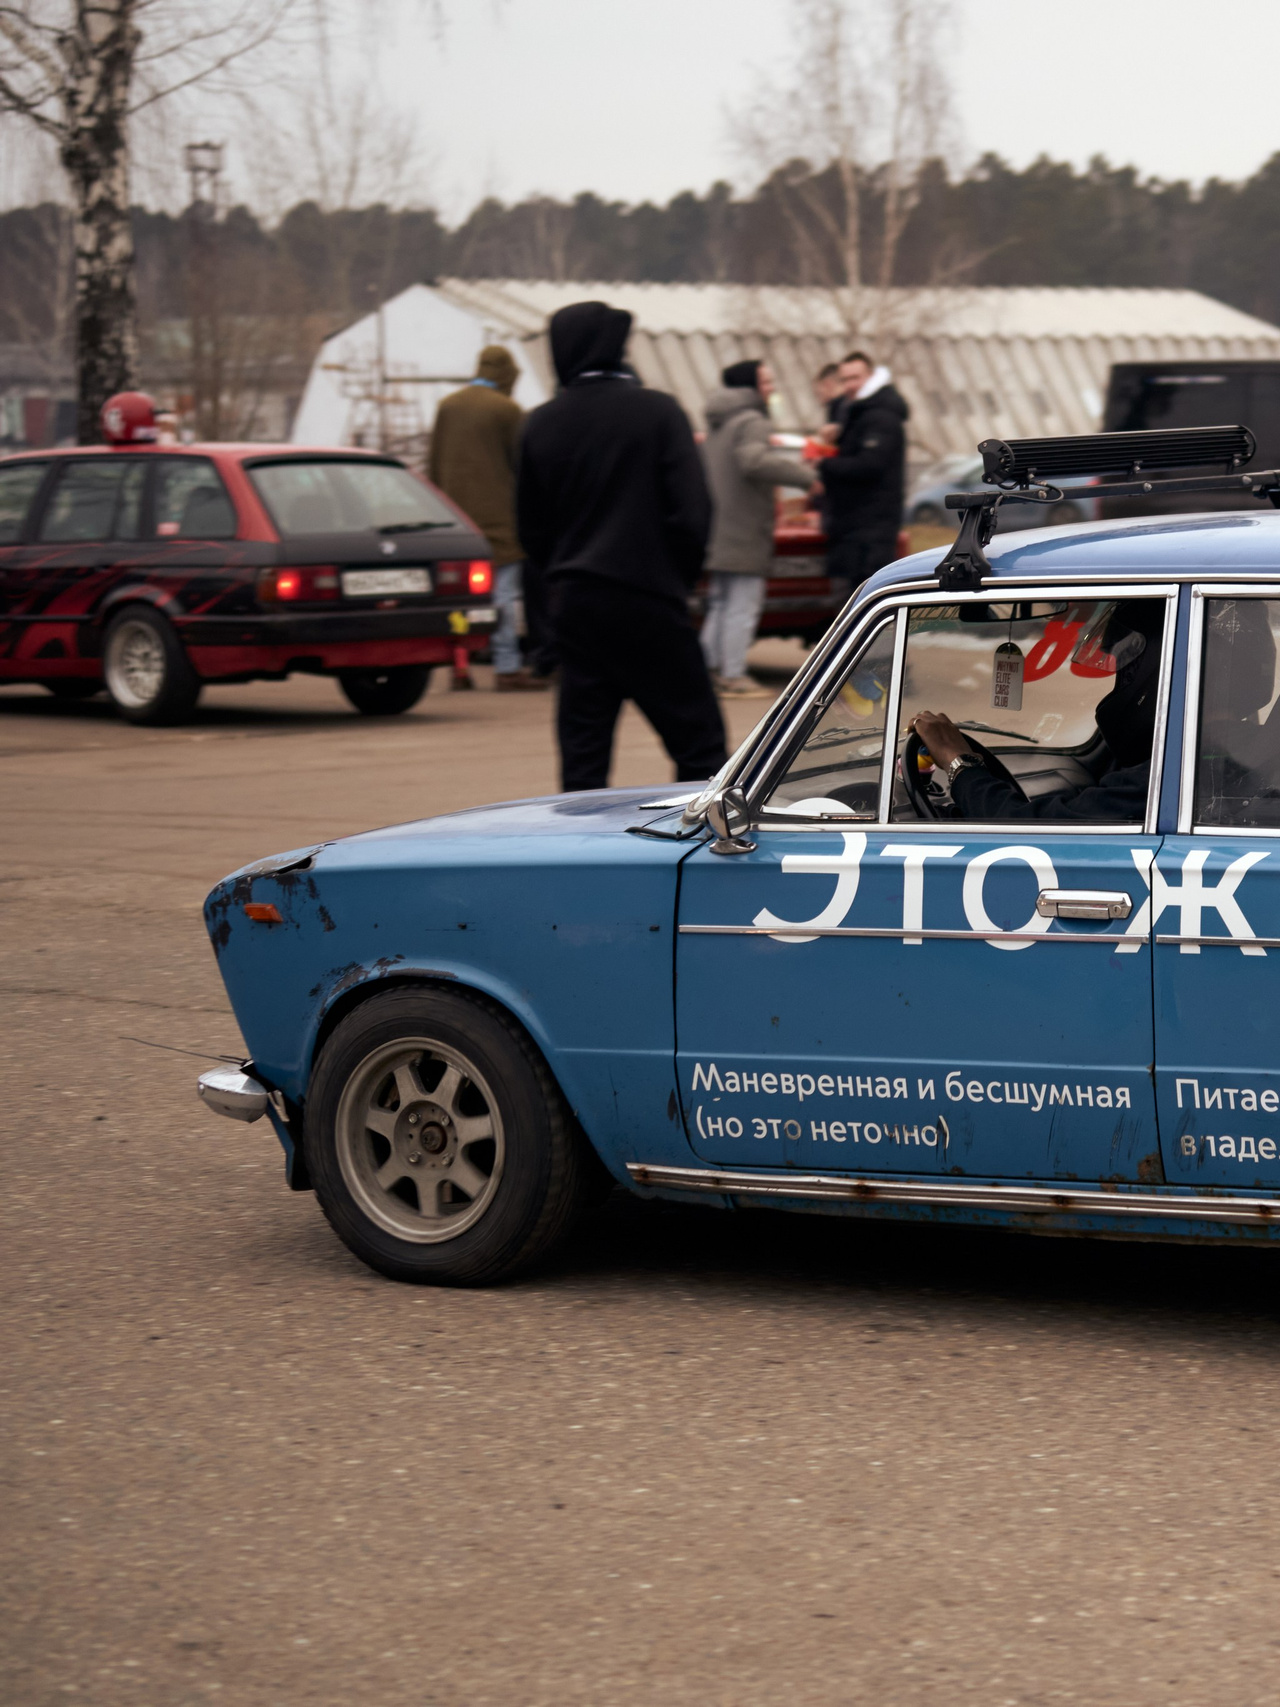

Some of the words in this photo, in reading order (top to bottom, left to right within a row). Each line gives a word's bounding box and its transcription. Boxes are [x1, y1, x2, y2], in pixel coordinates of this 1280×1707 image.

[995, 672, 1012, 685] ELITE
[994, 684, 1010, 696] CARS
[993, 696, 1009, 708] CLUB
[692, 1062, 909, 1102] Маневренная
[918, 1079, 935, 1101] и
[945, 1070, 1131, 1112] бесшумная
[696, 1106, 744, 1140] (но
[752, 1117, 801, 1141] это
[811, 1114, 950, 1148] неточно)
